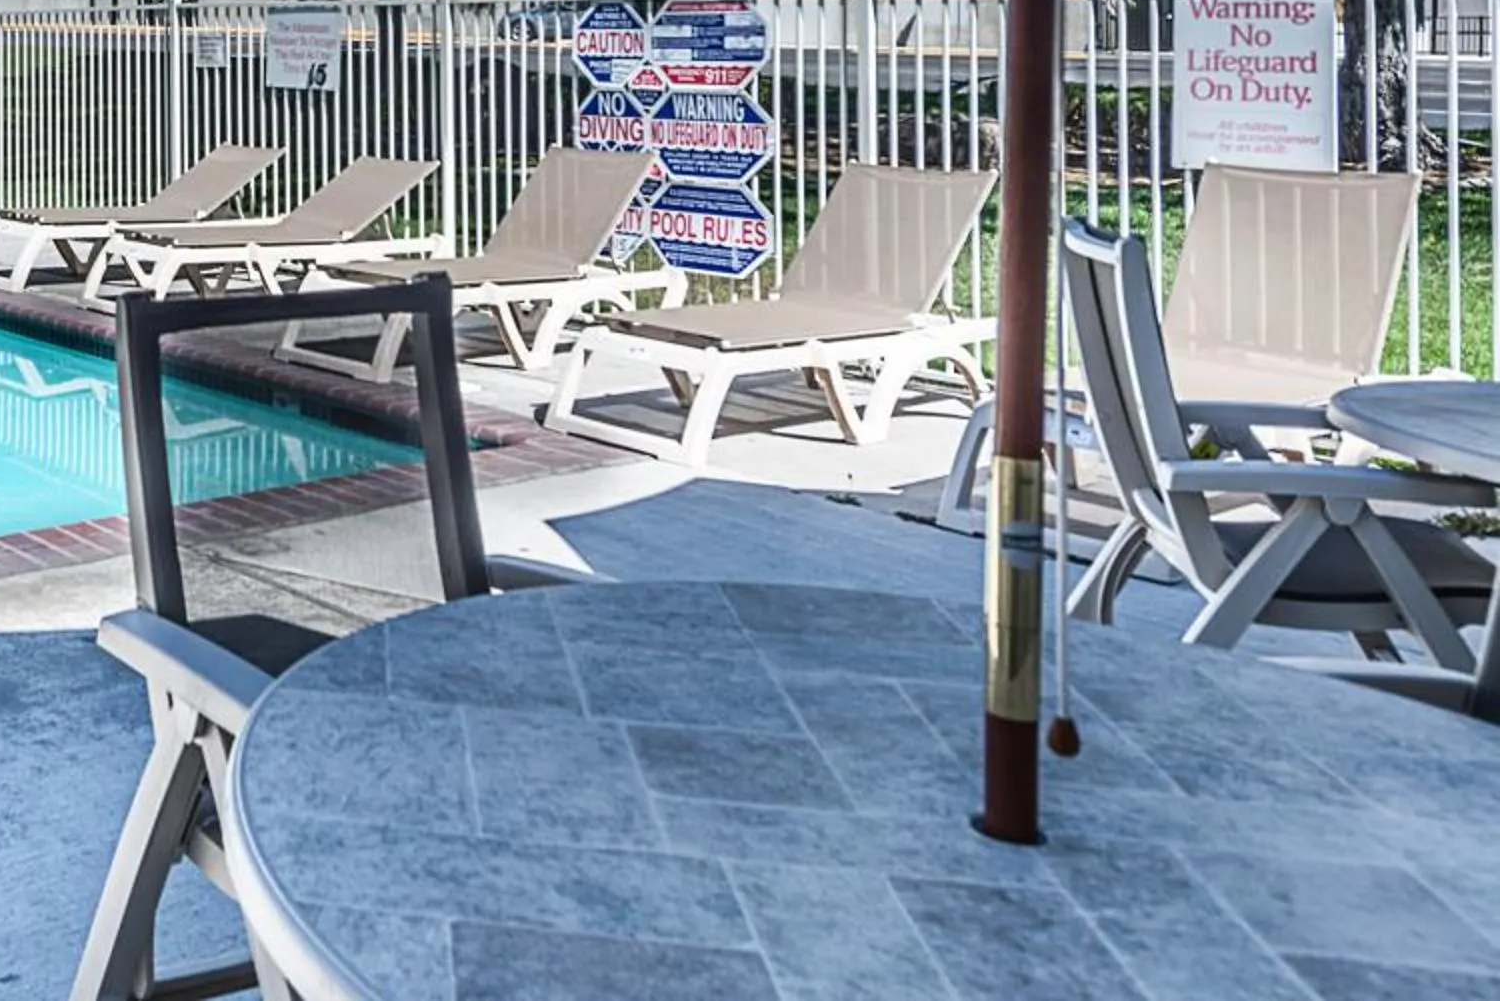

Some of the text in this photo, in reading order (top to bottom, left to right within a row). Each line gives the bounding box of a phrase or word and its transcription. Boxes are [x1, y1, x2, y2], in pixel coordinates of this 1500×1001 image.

[577, 31, 644, 54] CAUTION
[1229, 23, 1272, 48] No
[306, 62, 328, 88] 15
[705, 68, 727, 84] 911
[1187, 49, 1318, 77] Lifeguard
[599, 93, 626, 116] NO
[1190, 76, 1313, 110] On Duty.
[672, 95, 745, 122] WARNING
[579, 116, 644, 142] DIVING
[651, 121, 769, 151] NO LIFEGUARD ON DUTY
[650, 210, 697, 238] POOL
